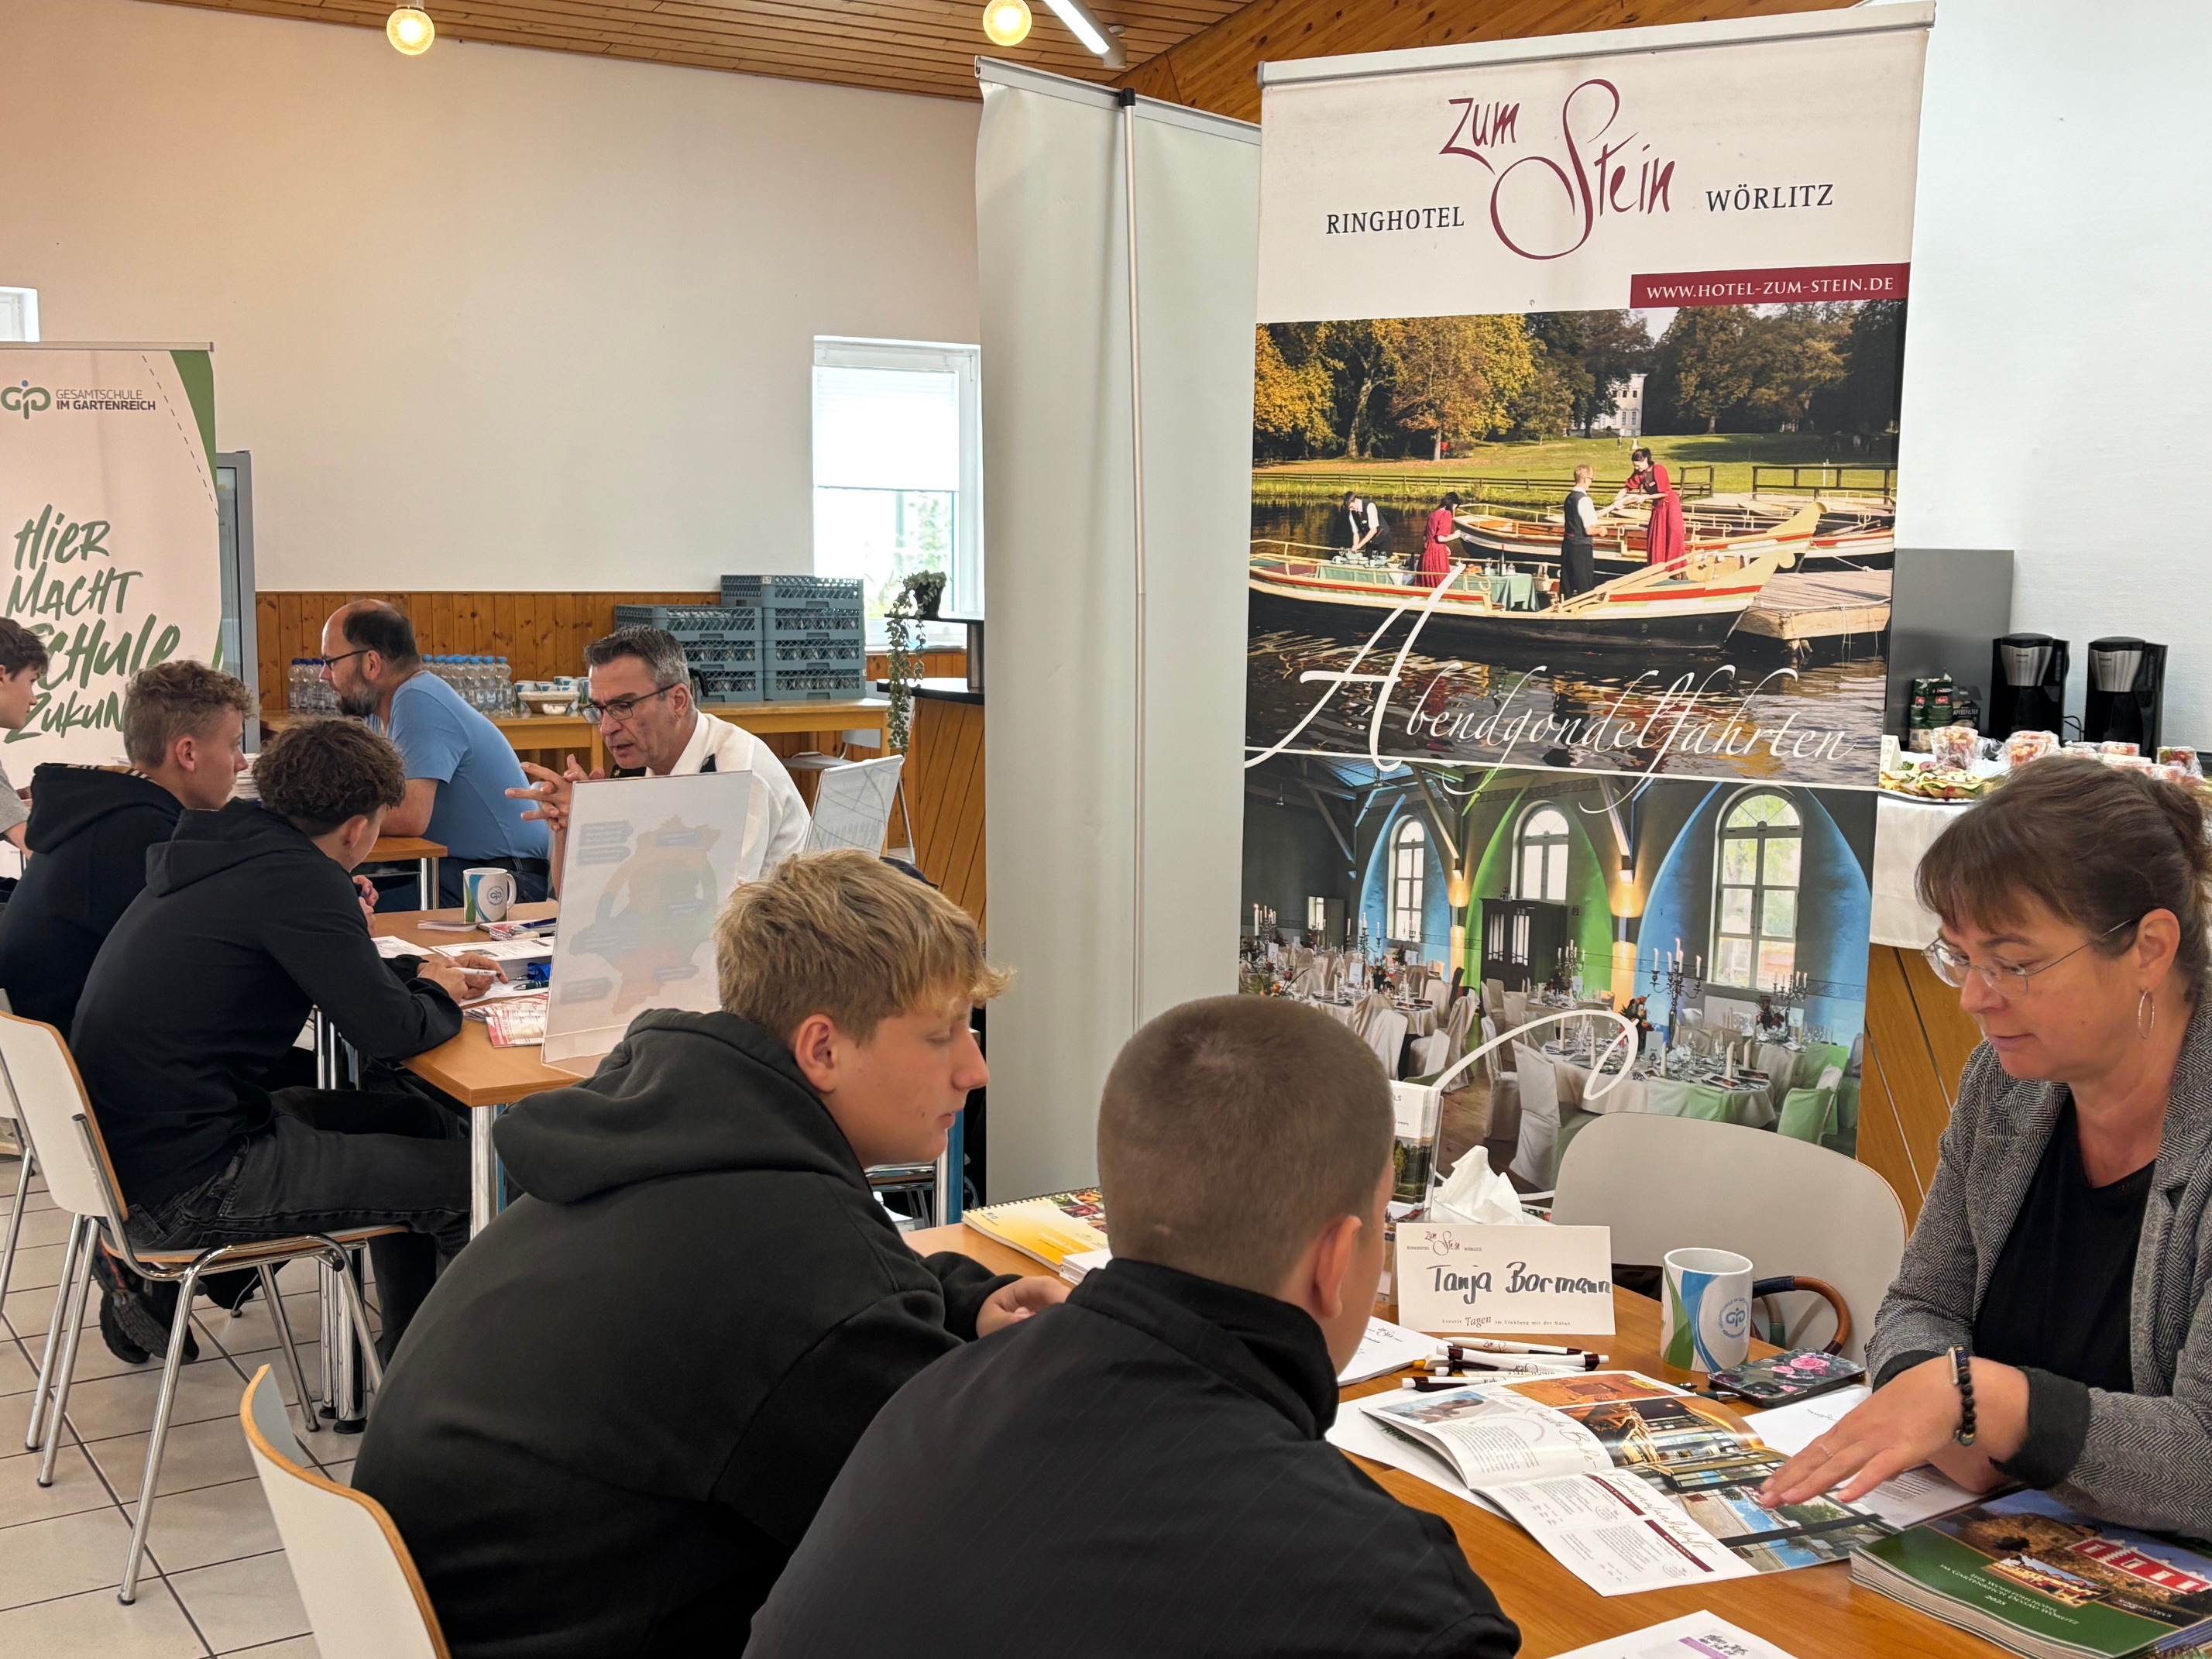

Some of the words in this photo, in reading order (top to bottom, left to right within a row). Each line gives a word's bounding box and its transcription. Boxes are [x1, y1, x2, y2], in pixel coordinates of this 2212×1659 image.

[1490, 78, 1677, 259] Stein
[1326, 206, 1465, 235] RINGHOTEL
[1705, 184, 1834, 213] WÖRLITZ
[1647, 277, 1894, 299] WWW.HOTEL-ZUM-STEIN.DE
[56, 390, 143, 400] GESAMTSCHULE
[57, 400, 70, 410] IM
[74, 400, 156, 410] GARTENREICH
[5, 562, 143, 621] MACHT
[1245, 563, 1856, 814] Abendgondelfahrten
[1433, 1231, 1461, 1255] Stein
[1426, 1264, 1492, 1304] Tanja
[1505, 1261, 1612, 1294] Bormann
[1465, 1316, 1492, 1328] Tagen
